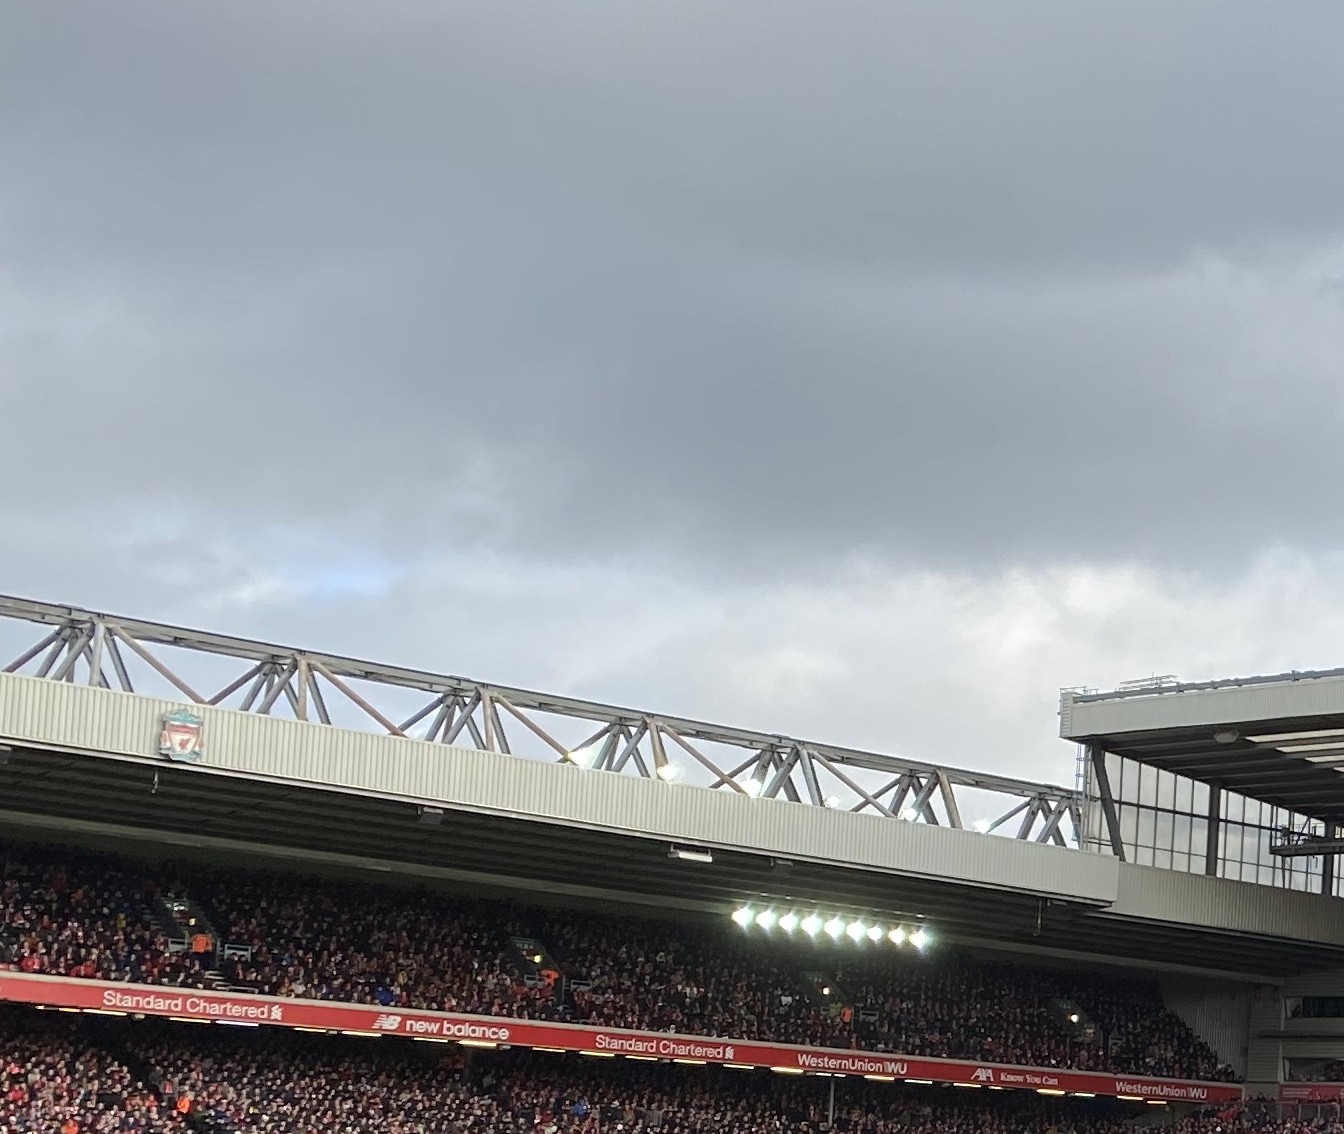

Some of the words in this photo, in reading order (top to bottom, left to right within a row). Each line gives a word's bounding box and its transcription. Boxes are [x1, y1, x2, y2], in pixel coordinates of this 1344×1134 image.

[103, 990, 182, 1012] Standard
[186, 998, 268, 1019] Chartered
[405, 1018, 441, 1034] new
[443, 1020, 510, 1040] balance
[595, 1035, 657, 1053] Standard
[659, 1040, 723, 1058] Chartered
[970, 1068, 994, 1082] AXA
[1000, 1072, 1024, 1083] Know
[1025, 1074, 1041, 1084] You
[1042, 1075, 1058, 1085] Can
